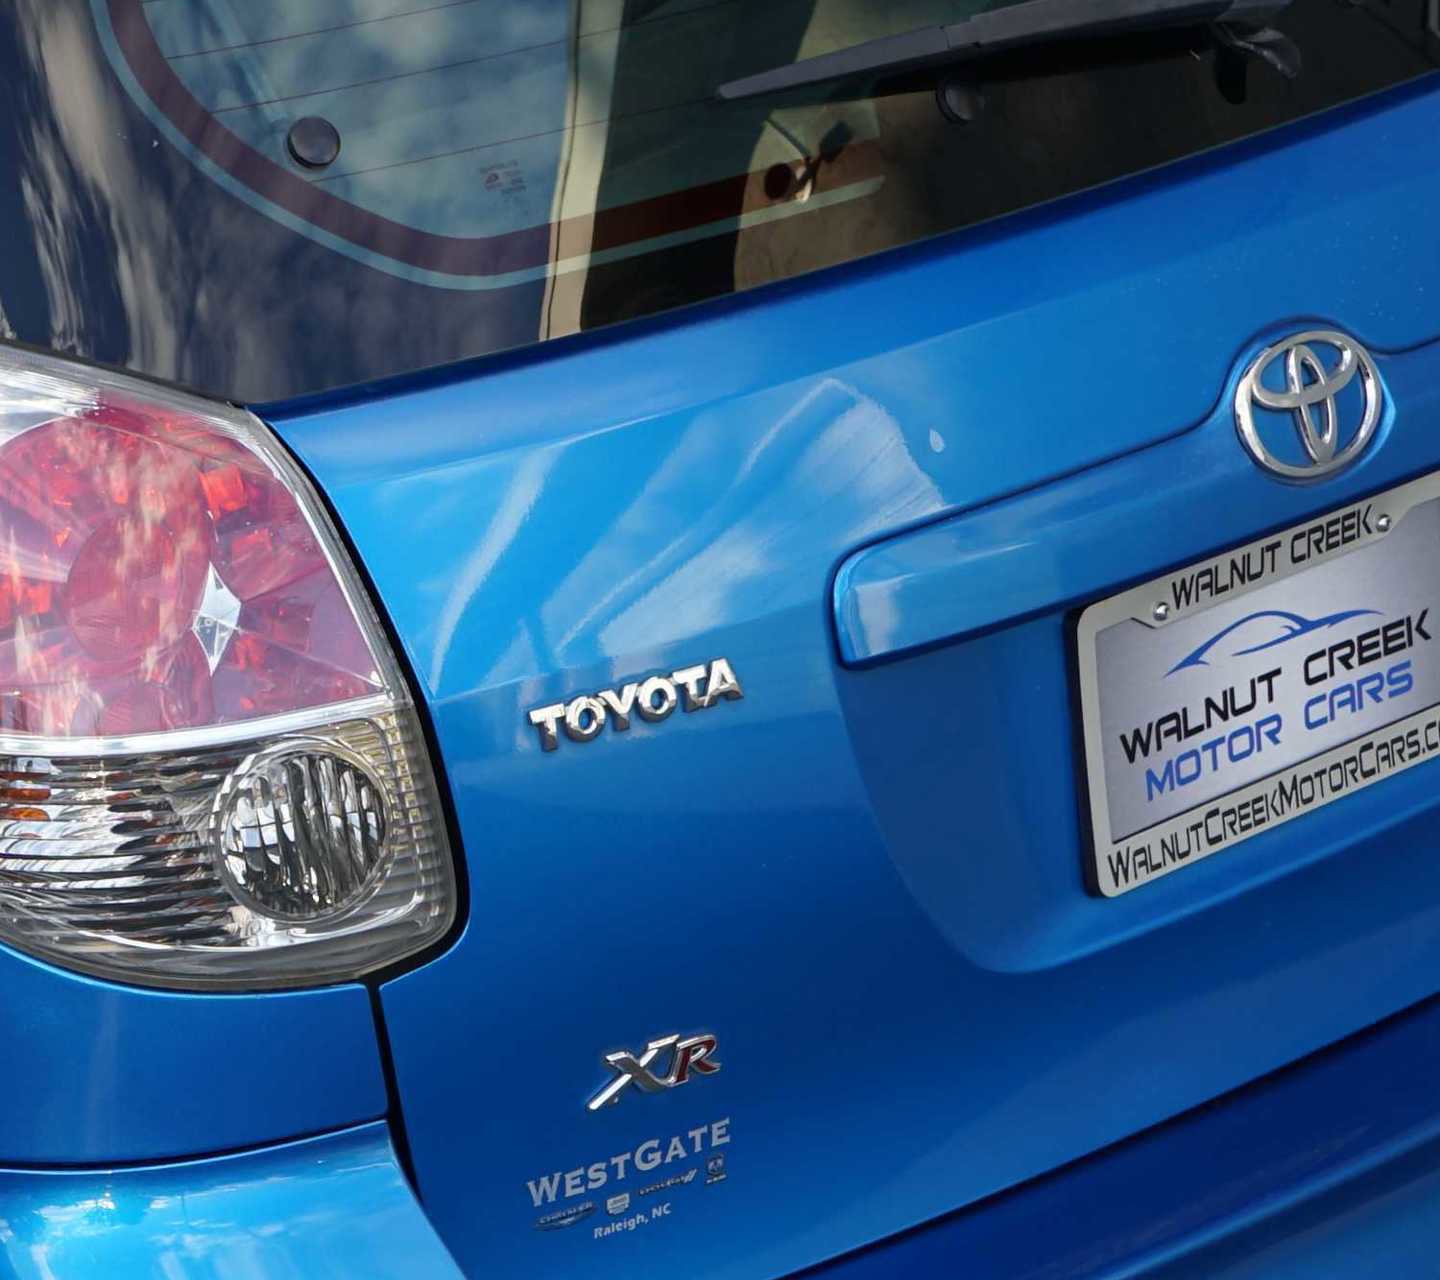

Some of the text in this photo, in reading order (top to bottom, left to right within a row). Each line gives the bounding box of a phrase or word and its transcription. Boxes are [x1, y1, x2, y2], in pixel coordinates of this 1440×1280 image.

[1171, 504, 1375, 608] WALNUT CREEK
[528, 657, 744, 752] TOYOTA
[1120, 608, 1432, 764] WALNUT CREEK
[1145, 660, 1413, 801] MOTOR CARS
[585, 1034, 721, 1111] XR
[526, 1118, 731, 1207] WESTGATE
[594, 1211, 649, 1239] Raleigh,
[652, 1203, 672, 1220] NC
